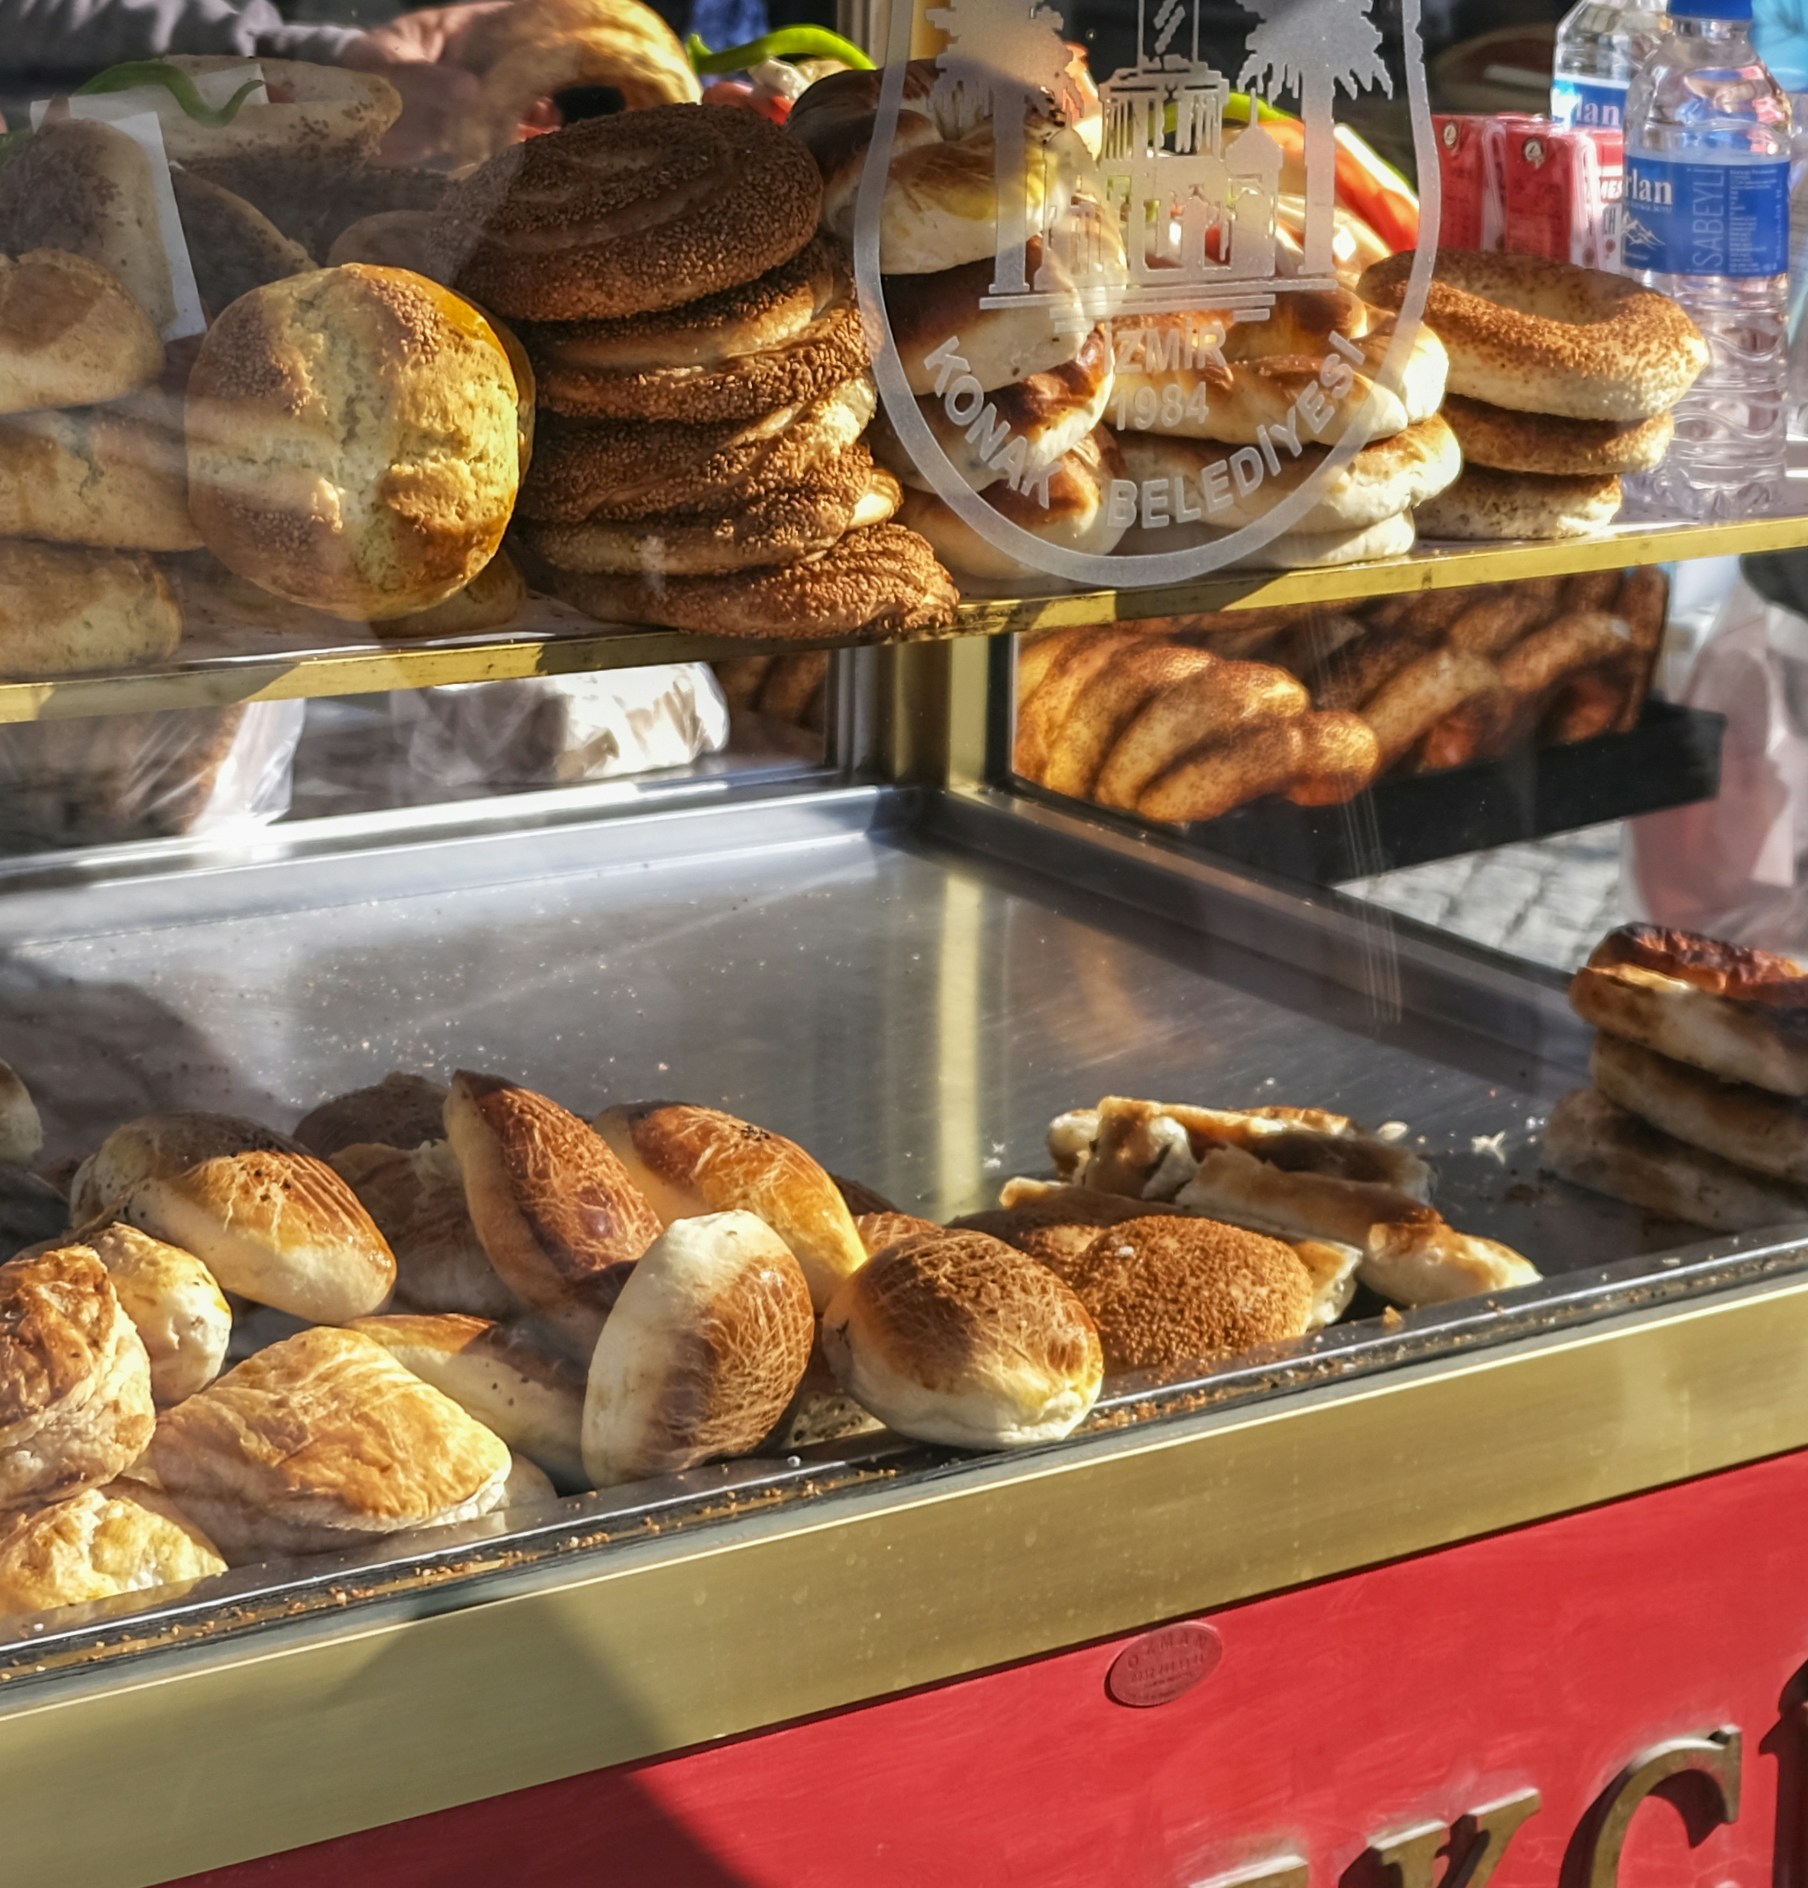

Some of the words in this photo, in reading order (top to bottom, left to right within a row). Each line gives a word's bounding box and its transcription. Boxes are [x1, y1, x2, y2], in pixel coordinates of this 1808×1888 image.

[1625, 168, 1674, 206] rlan
[1102, 321, 1228, 374] İZMİR
[923, 335, 1062, 509] KONAK
[1110, 381, 1210, 431] 1984
